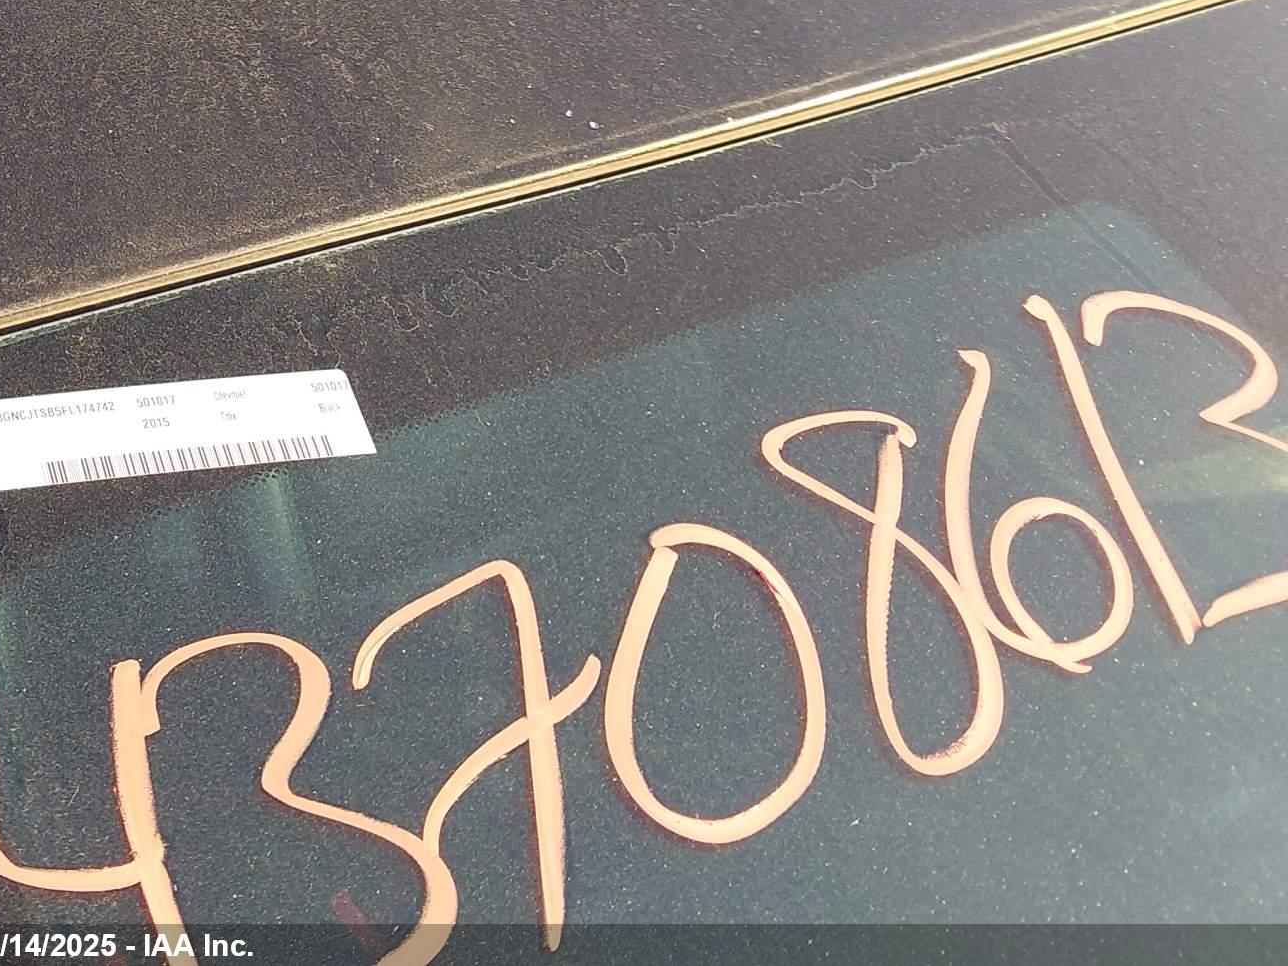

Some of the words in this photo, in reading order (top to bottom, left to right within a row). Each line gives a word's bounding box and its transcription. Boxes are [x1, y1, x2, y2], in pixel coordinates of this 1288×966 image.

[136, 394, 176, 409] 501017
[310, 380, 349, 392] 501017
[142, 417, 171, 429] 2015
